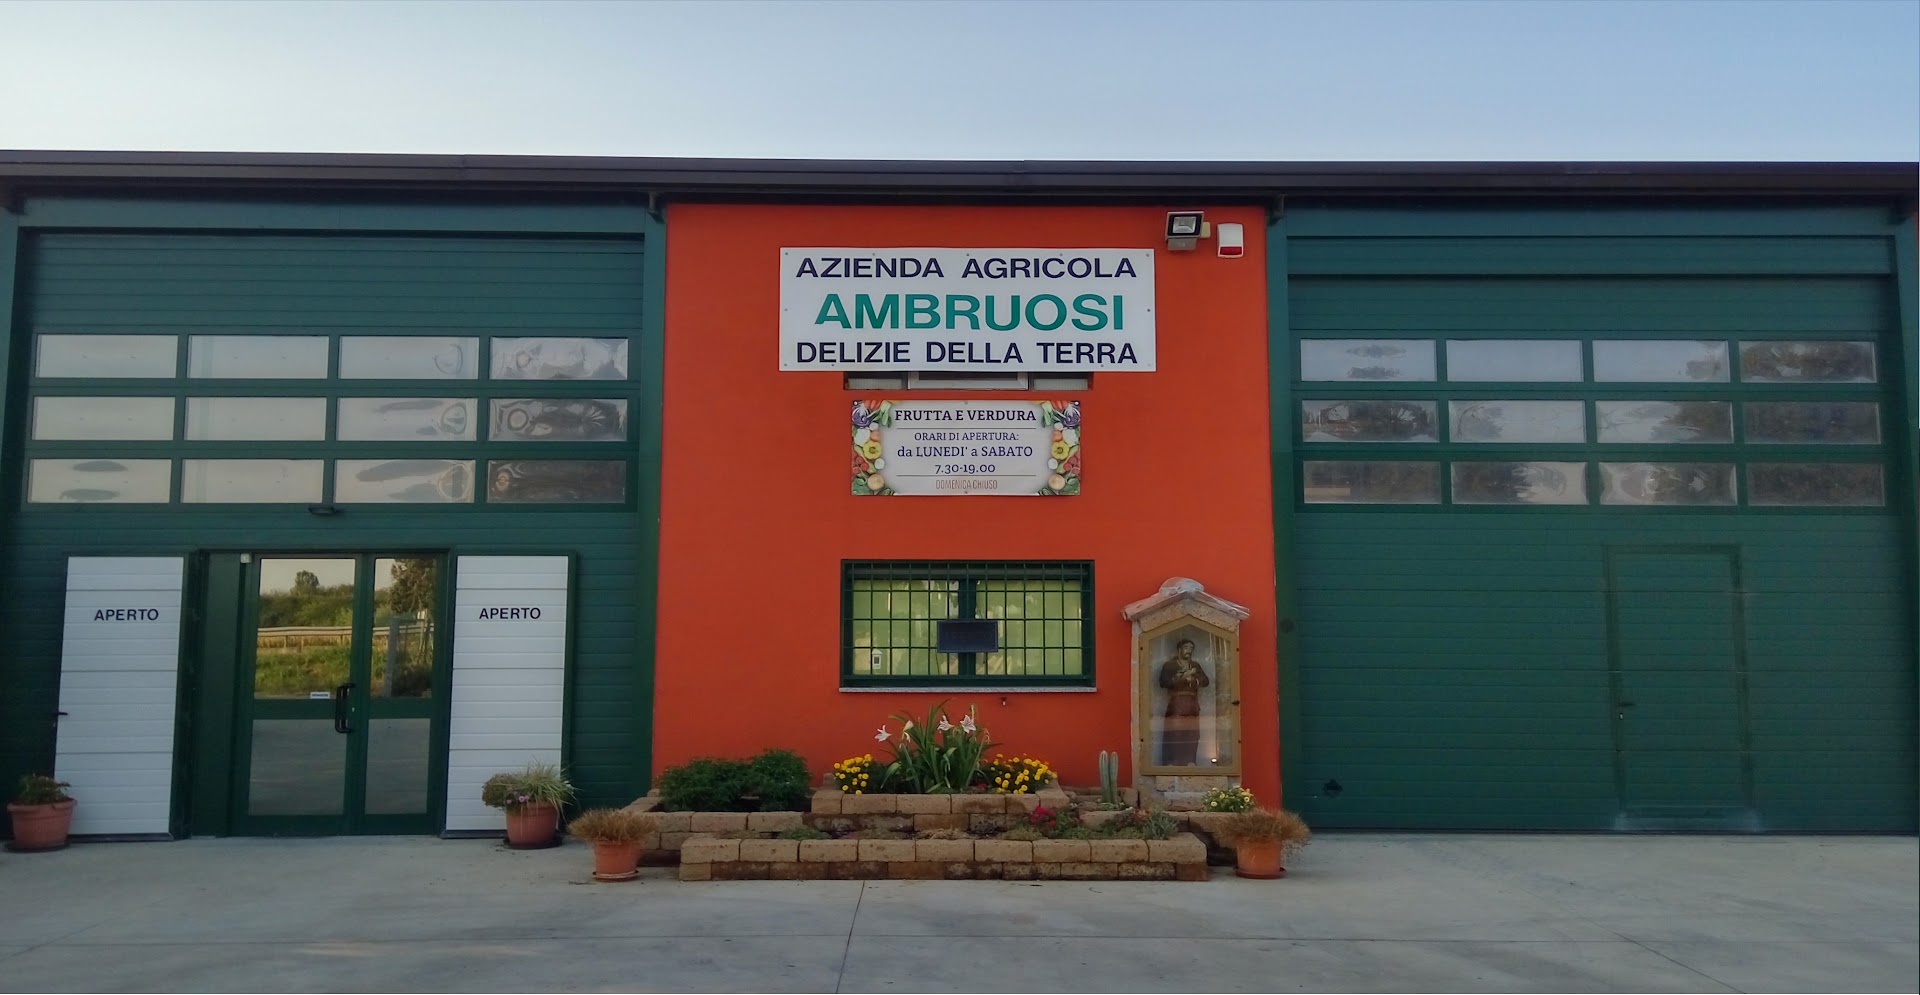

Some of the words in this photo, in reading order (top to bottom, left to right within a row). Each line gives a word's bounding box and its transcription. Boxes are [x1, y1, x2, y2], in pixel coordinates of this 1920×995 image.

[796, 257, 944, 278] AZIENDA
[961, 257, 1137, 279] AGRICOLA
[814, 293, 1124, 332] AMBRUOSI
[797, 341, 911, 363] DELIZIE
[926, 341, 1024, 364] DELLA
[1036, 342, 1138, 364] TERRA
[894, 410, 952, 421] FRUTTA
[955, 410, 964, 421] E
[967, 410, 1037, 421] VERDURA
[914, 432, 947, 441] ORARI
[949, 432, 960, 441] DI
[961, 432, 1020, 441] APERTURA:
[897, 445, 913, 457] da
[915, 446, 968, 458] LUNEDI'
[970, 448, 979, 457] a
[981, 446, 1033, 457] SABATO
[934, 464, 996, 475] 7.30-19.00
[935, 479, 972, 490] DOMENICA
[973, 479, 998, 490] CHIUSO
[93, 608, 160, 621] APERTO
[479, 607, 542, 620] APERTO
